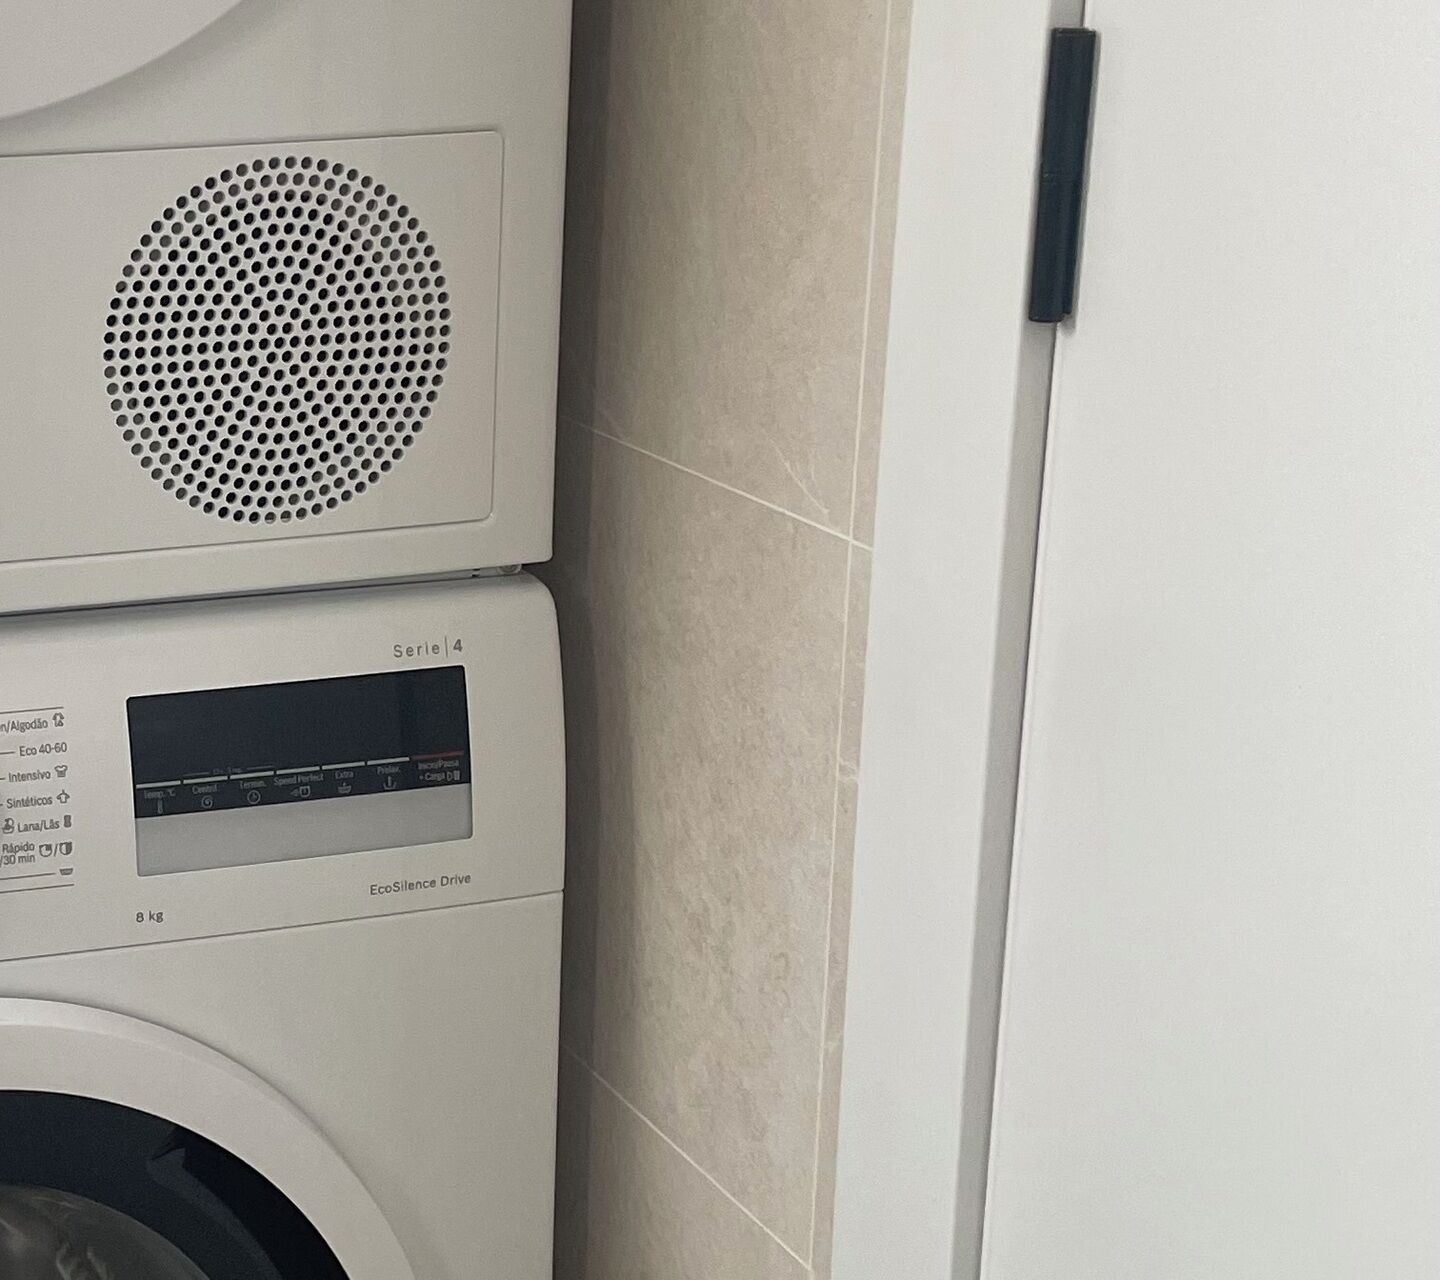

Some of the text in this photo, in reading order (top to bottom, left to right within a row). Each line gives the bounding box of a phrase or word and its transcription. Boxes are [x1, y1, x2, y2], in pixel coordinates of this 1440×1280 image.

[19, 742, 67, 756] Eco 40-60
[8, 769, 51, 782] Intensivo
[6, 796, 53, 809] Sintéticos
[2, 841, 35, 854] Rápido
[18, 853, 35, 864] min
[370, 874, 471, 895] EcoSilence Drive
[136, 910, 164, 923] 8 kg
